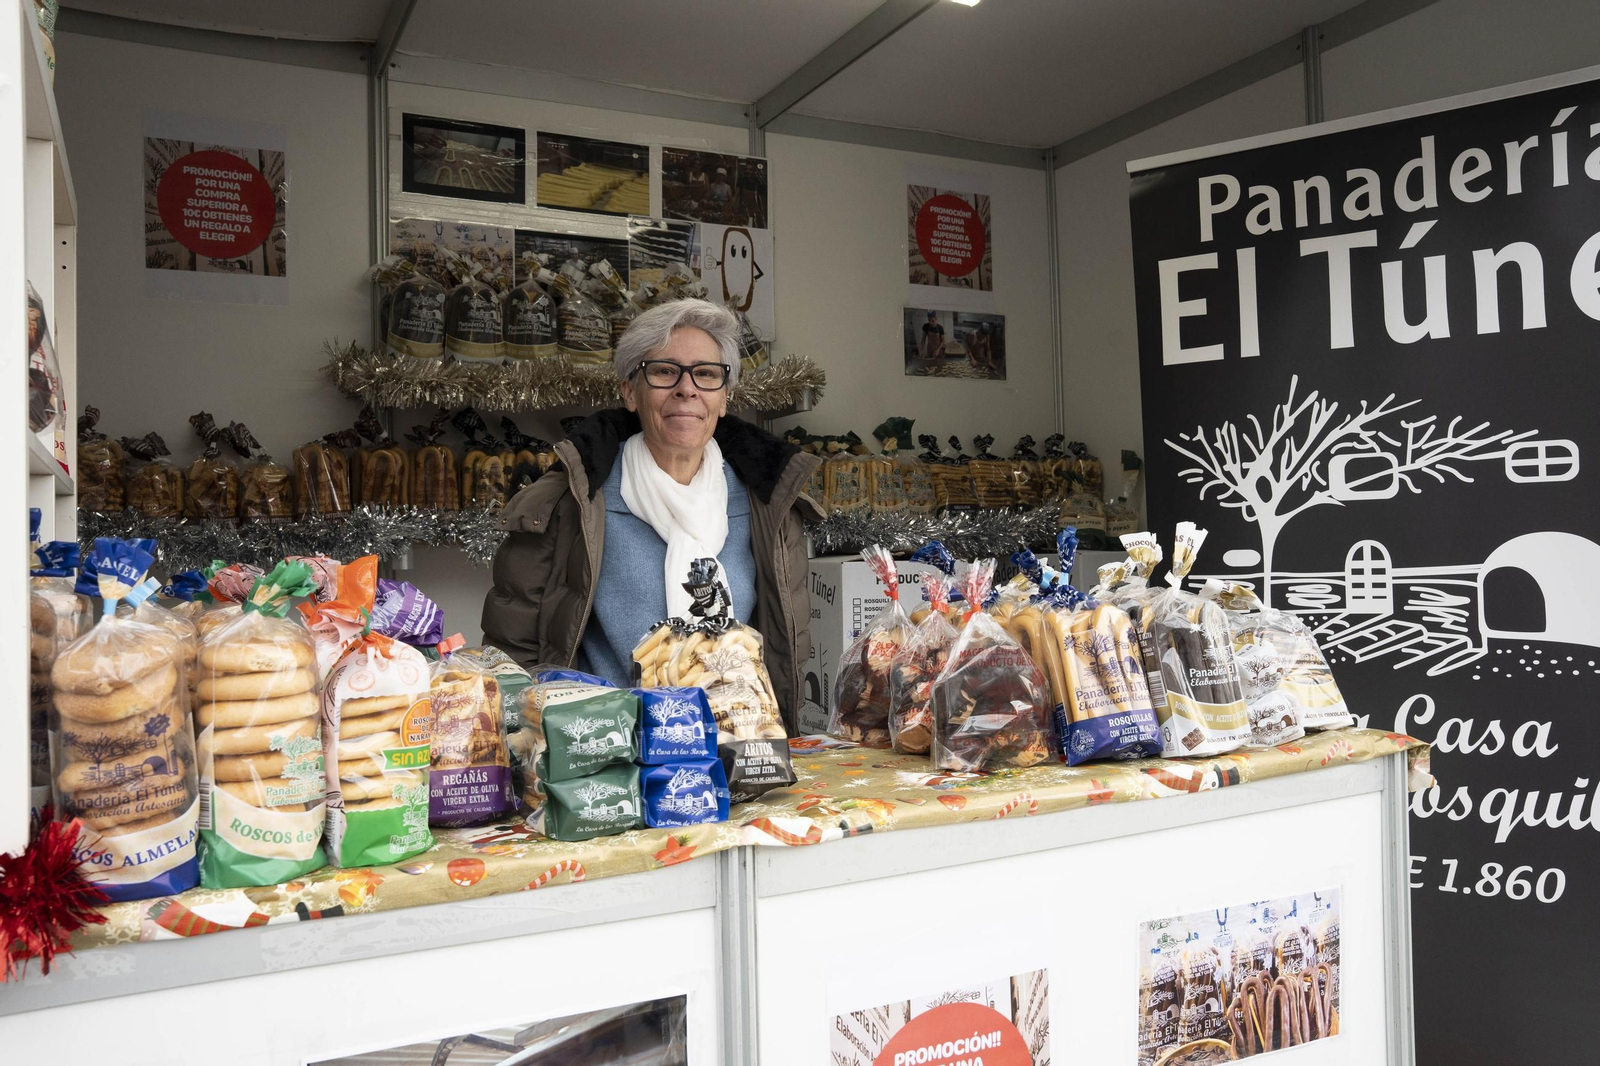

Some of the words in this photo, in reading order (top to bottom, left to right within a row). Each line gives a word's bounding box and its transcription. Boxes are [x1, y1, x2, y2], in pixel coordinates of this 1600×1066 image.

[183, 165, 253, 182] PROMOCIÓN!!
[195, 178, 217, 188] POR
[218, 180, 241, 191] UNA
[195, 188, 241, 202] COMPRA
[187, 198, 240, 212] SUPERIOR
[240, 204, 249, 213] A
[930, 206, 972, 218] PROMOCIÓN!!
[202, 210, 253, 224] OBTIENES
[937, 215, 950, 223] POR
[951, 217, 965, 226] UNA
[184, 219, 201, 229] UN
[201, 221, 243, 233] REGALO
[243, 225, 251, 234] A
[937, 223, 965, 234] COMPRA
[199, 231, 236, 243] ELEGIR
[932, 230, 964, 241] SUPERIOR
[942, 239, 972, 250] OBTIENES
[941, 247, 966, 257] REGALO
[940, 255, 963, 265] ELEGIR
[1158, 246, 1260, 367] El
[811, 572, 836, 606] Túnel
[1108, 713, 1153, 728] ROSQUILLAS
[1394, 693, 1559, 758] Casa
[1109, 730, 1121, 738] CON
[1122, 726, 1139, 736] ACEITE
[1120, 735, 1138, 744] VIRGEN
[744, 742, 774, 757] ARITOS
[392, 752, 414, 766] SIN
[568, 762, 577, 770] La
[578, 760, 591, 768] Casa
[736, 758, 746, 767] CON
[746, 758, 762, 766] ACEITE
[442, 769, 488, 786] REGAÑÁS
[744, 766, 761, 776] VIRGEN
[762, 766, 776, 774] EXTRA
[135, 788, 150, 802] El
[152, 781, 187, 799] Túnel
[430, 789, 446, 798] CON
[446, 786, 468, 797] ACEITE
[481, 784, 500, 794] OLIVA
[442, 797, 467, 806] VIRGEN
[469, 794, 490, 804] EXTRA
[229, 817, 292, 845] ROSCOS
[296, 830, 312, 843] de
[1438, 858, 1566, 904] 1.860
[894, 1030, 1002, 1066] PROMOCIÓN!!
